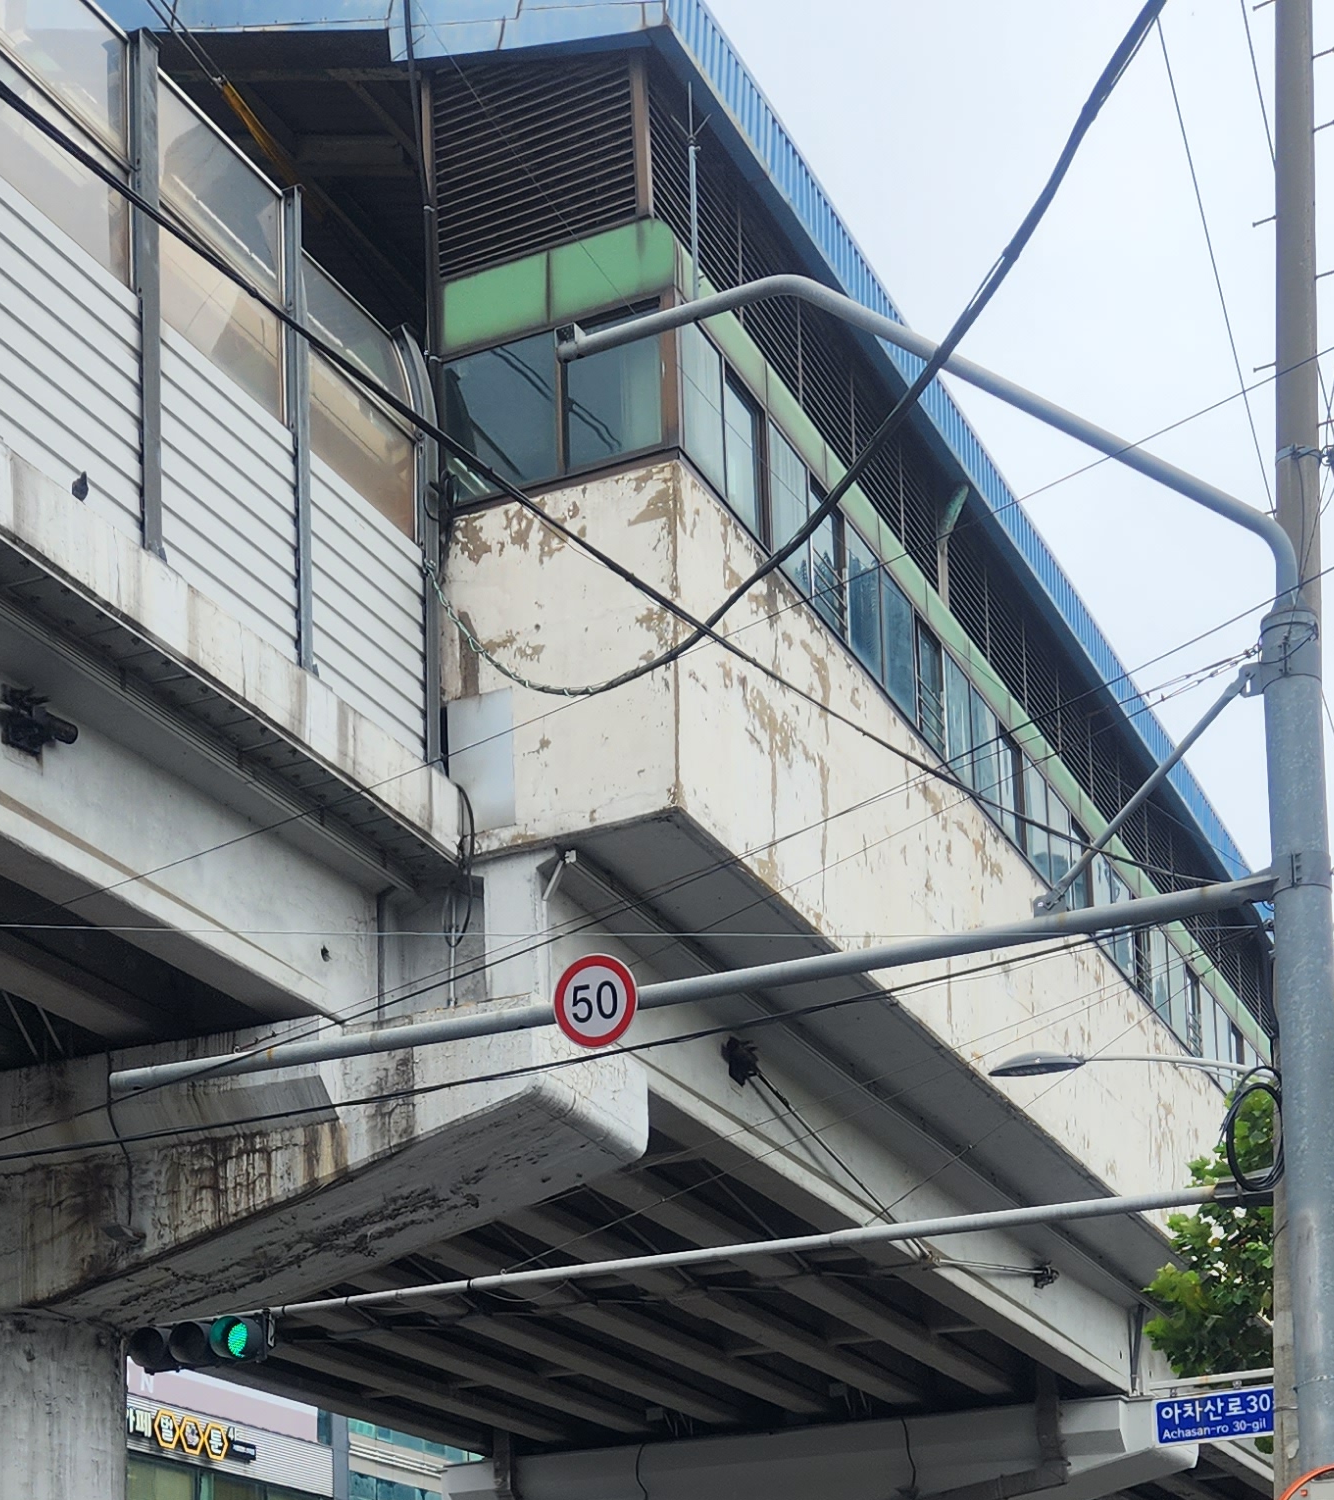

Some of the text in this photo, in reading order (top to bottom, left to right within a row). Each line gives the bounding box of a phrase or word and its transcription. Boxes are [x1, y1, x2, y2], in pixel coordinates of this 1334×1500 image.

[571, 980, 618, 1023] 50
[1160, 1386, 1273, 1426] 아차산로30
[1162, 1417, 1267, 1442] Achasan-ro 30-gil
